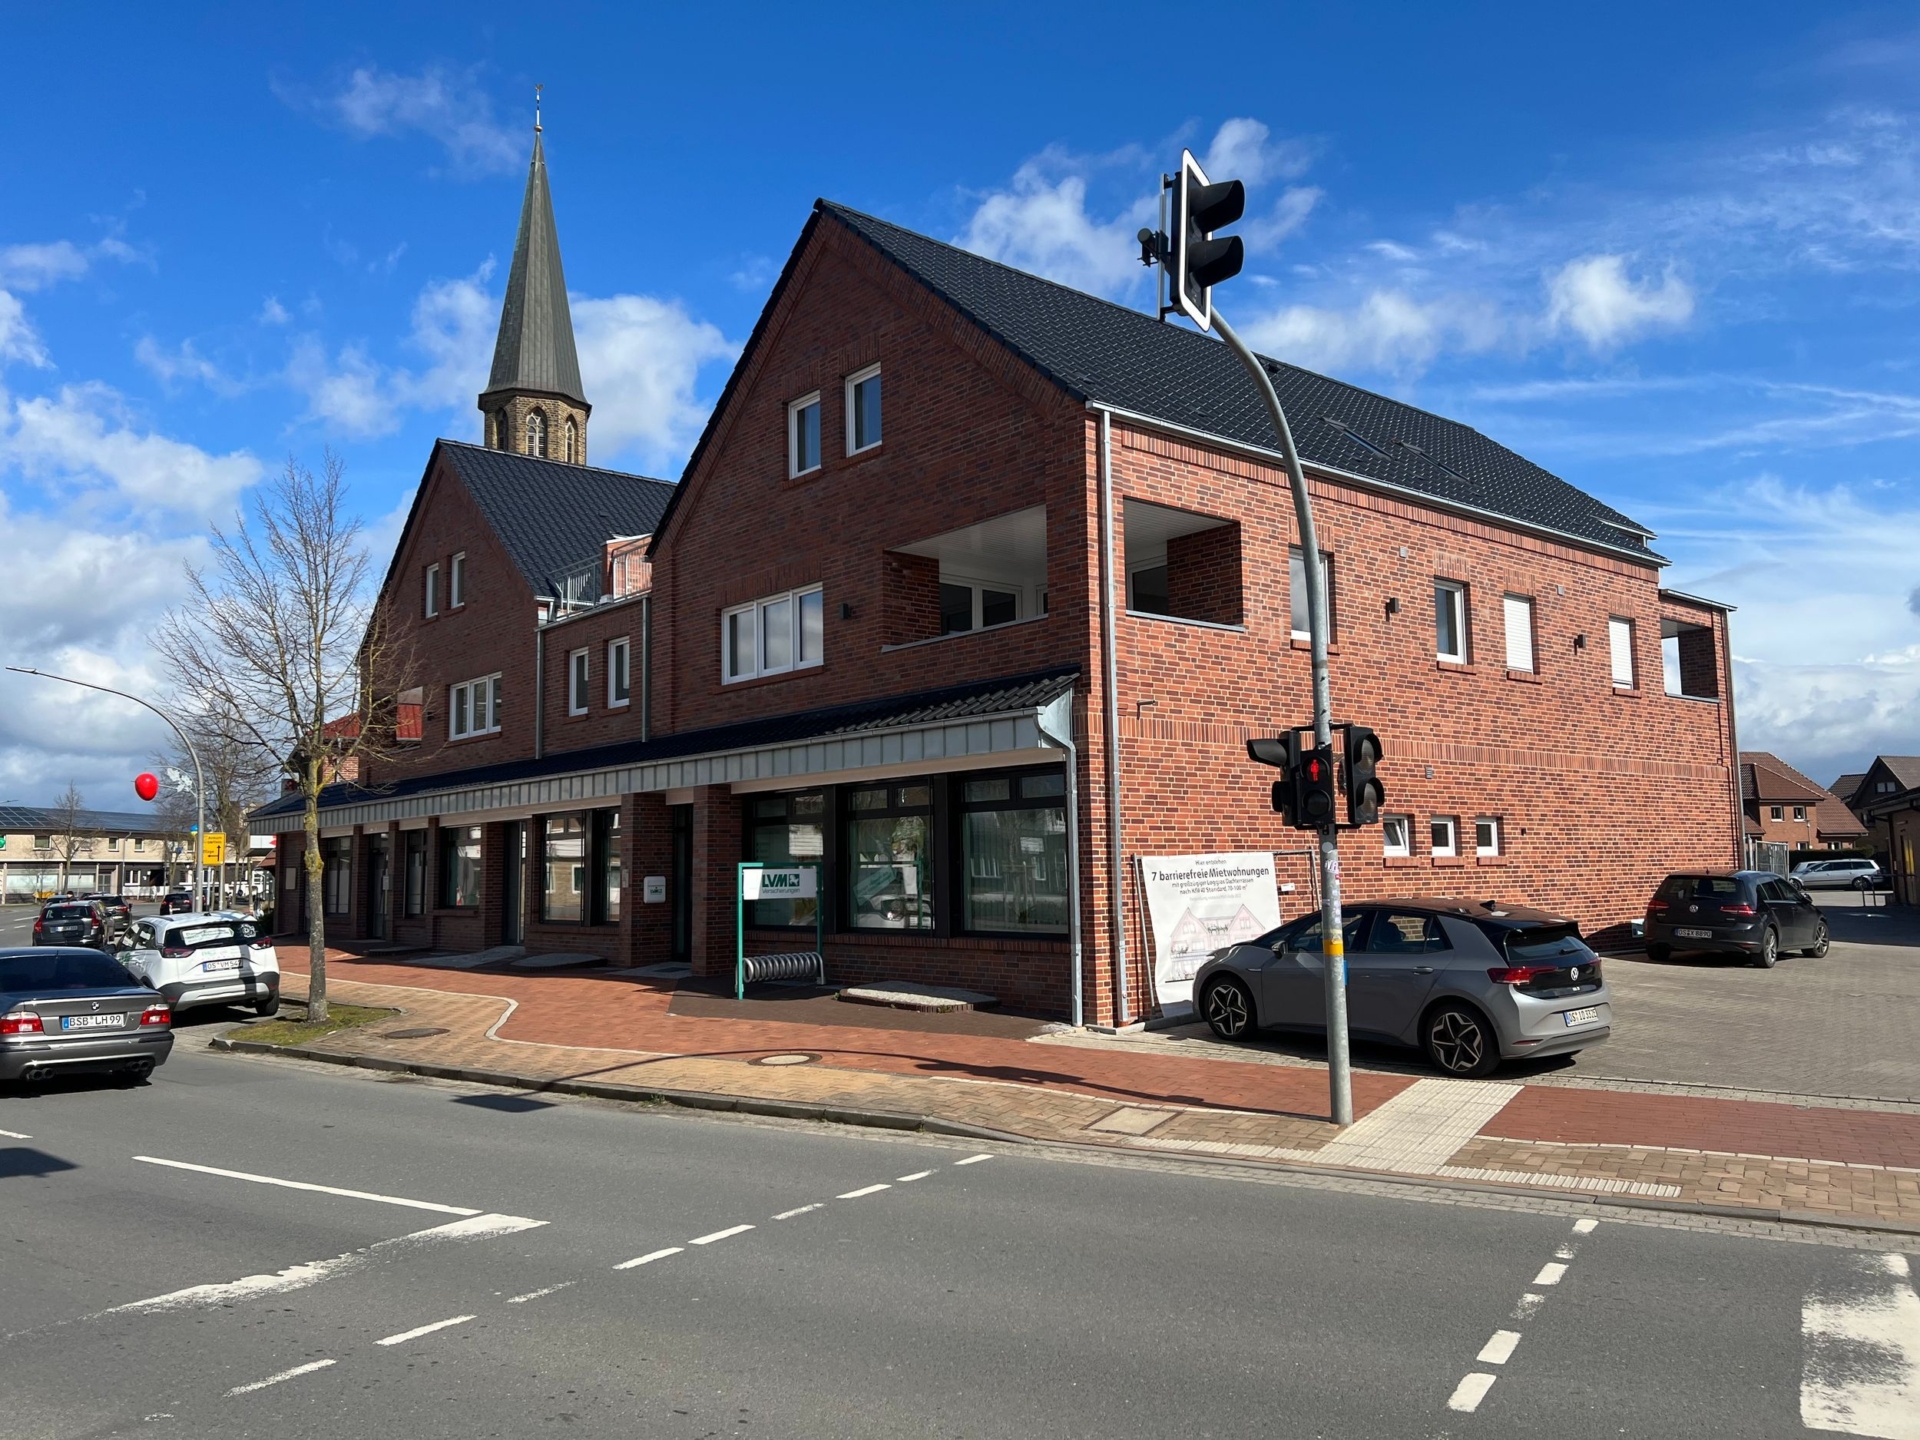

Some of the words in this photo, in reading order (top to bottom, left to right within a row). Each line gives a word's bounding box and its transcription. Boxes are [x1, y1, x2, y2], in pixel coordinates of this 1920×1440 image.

[762, 873, 788, 888] LVM
[1151, 871, 1158, 882] 7
[1159, 868, 1209, 882] barrierefreie
[1208, 866, 1269, 878] Mietwohnungen
[762, 887, 800, 895] Versicherungen
[207, 962, 217, 970] OS
[69, 1017, 89, 1027] BSB
[95, 1015, 108, 1025] LH
[109, 1014, 121, 1024] 99
